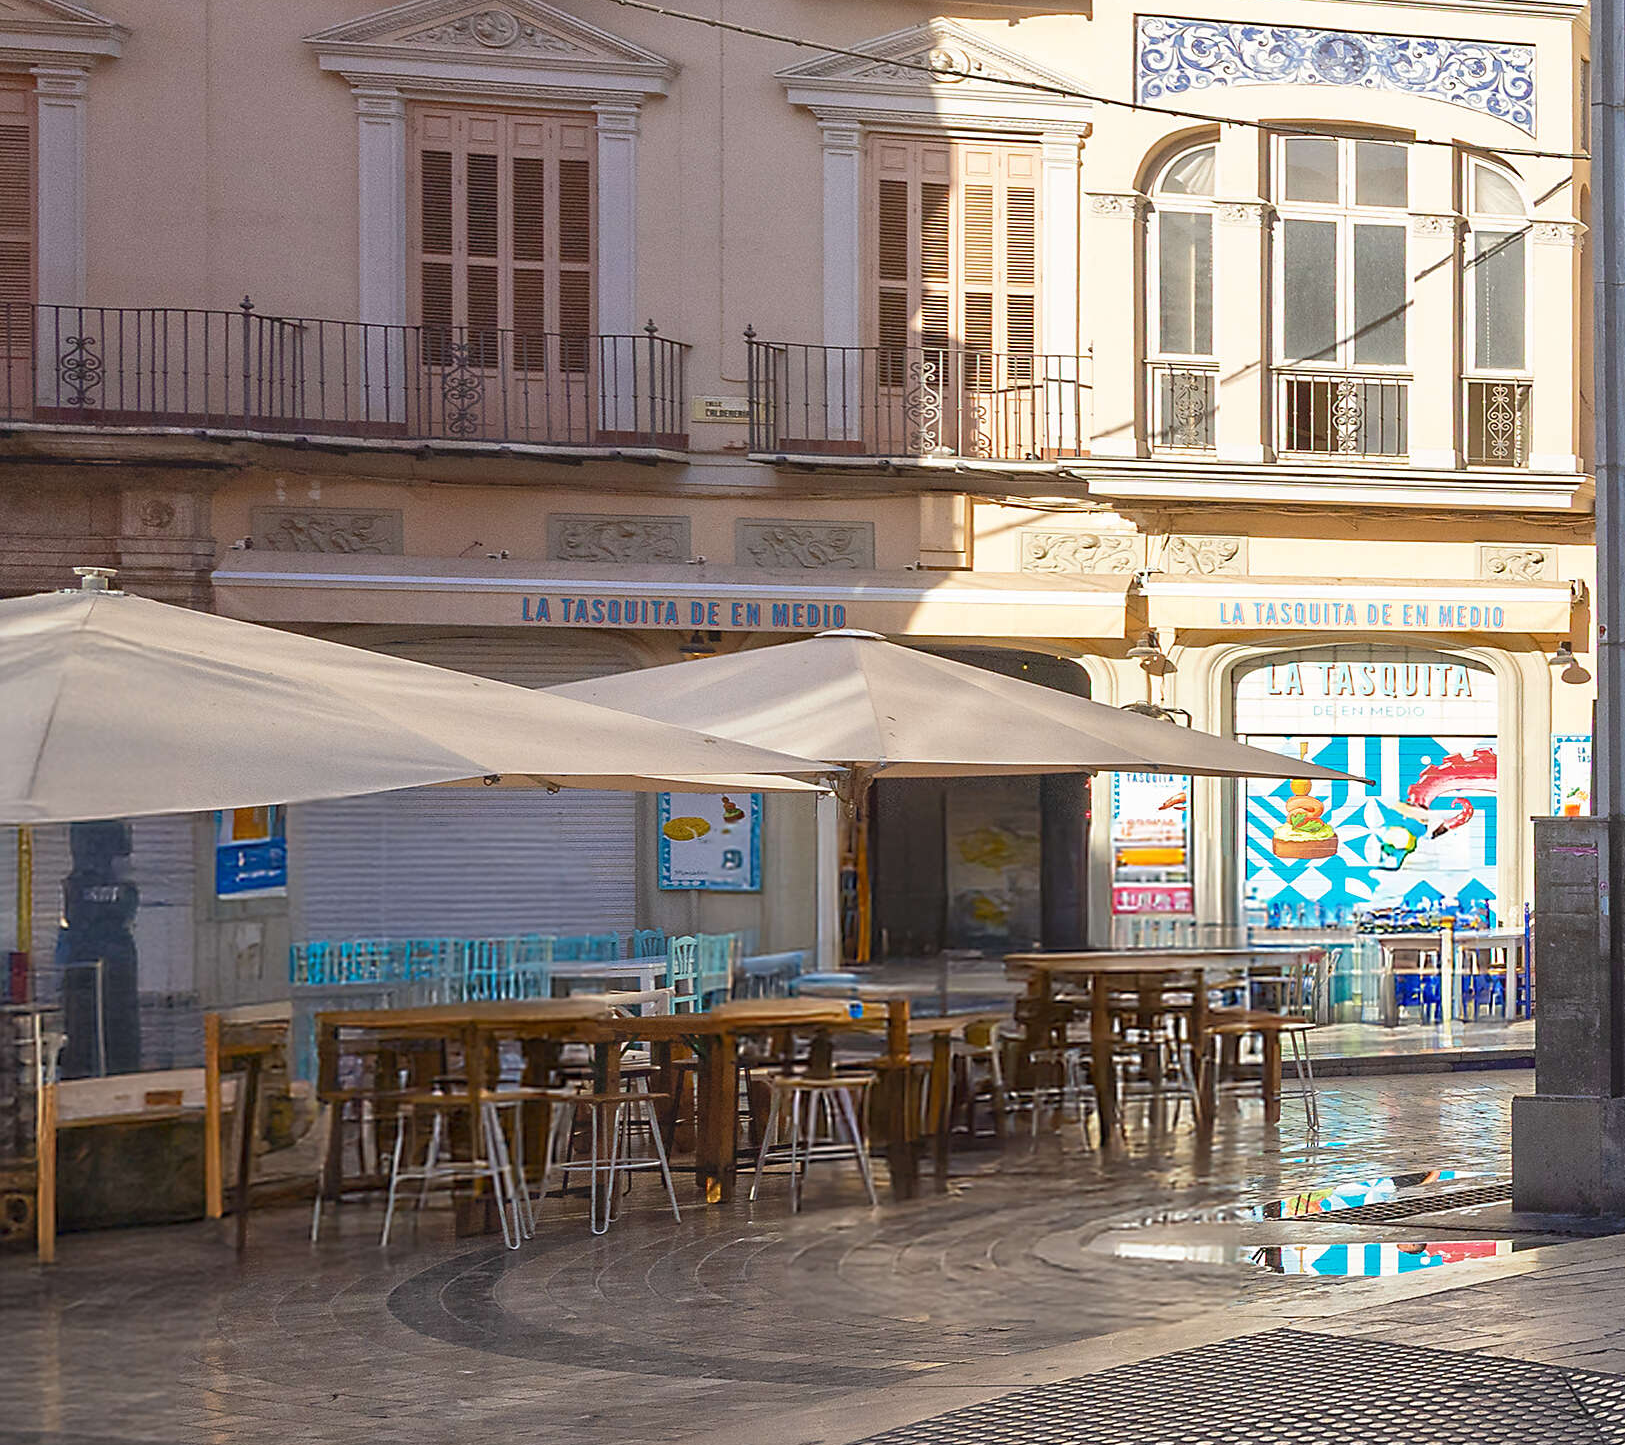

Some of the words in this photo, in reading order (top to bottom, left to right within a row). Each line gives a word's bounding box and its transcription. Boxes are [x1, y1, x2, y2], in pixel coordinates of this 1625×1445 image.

[522, 596, 550, 622] LA
[560, 598, 679, 625] TASQUITA
[690, 601, 720, 626] DE
[731, 602, 761, 627] EN
[772, 603, 846, 628] MEDIO
[1219, 602, 1245, 625] LA
[1253, 602, 1357, 627] TASQUITA
[1367, 603, 1392, 626] DE
[1402, 604, 1428, 627] EN
[1438, 605, 1505, 628] MEDIO
[1265, 663, 1304, 696] LA
[1319, 663, 1472, 699] TASQUITA
[1313, 705, 1335, 717] DE
[1341, 705, 1365, 717] EN
[1371, 705, 1425, 718] MEDIO
